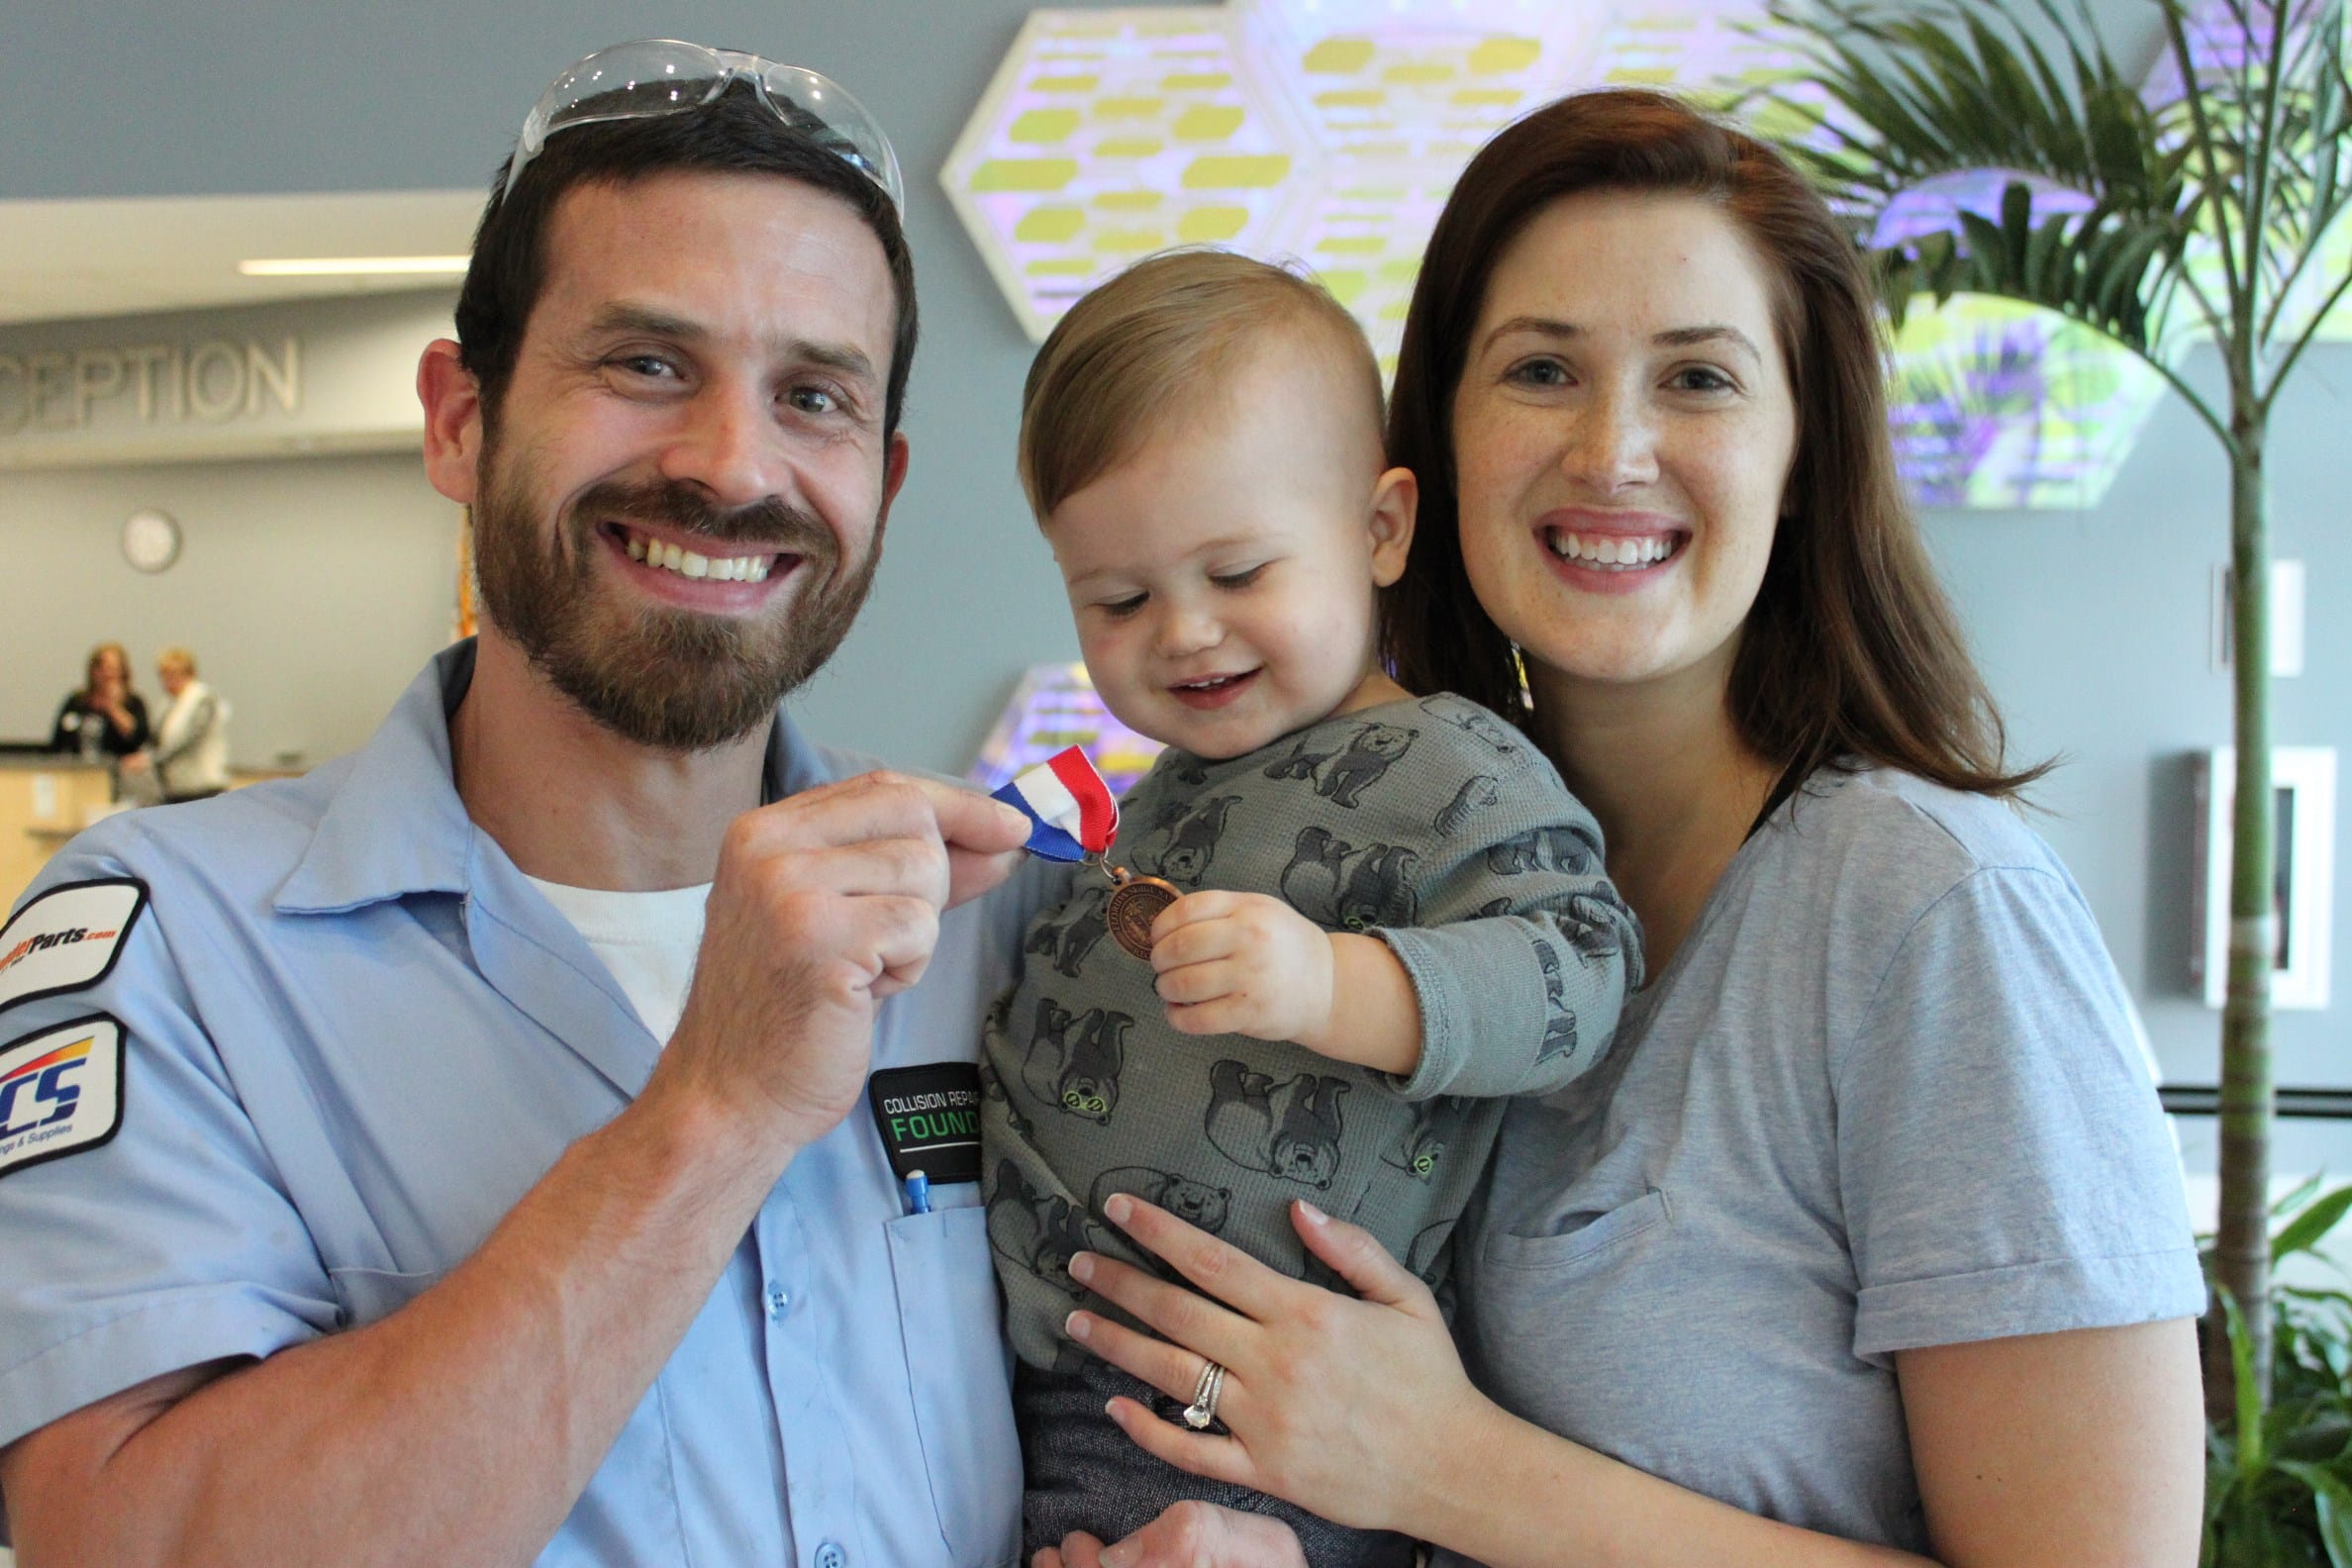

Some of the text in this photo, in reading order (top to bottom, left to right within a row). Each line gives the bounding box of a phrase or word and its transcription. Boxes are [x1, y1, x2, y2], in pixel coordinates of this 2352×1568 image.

[883, 1092, 946, 1115] COLLISION
[28, 1125, 73, 1144] Supplies
[891, 1111, 980, 1141] FOUND
